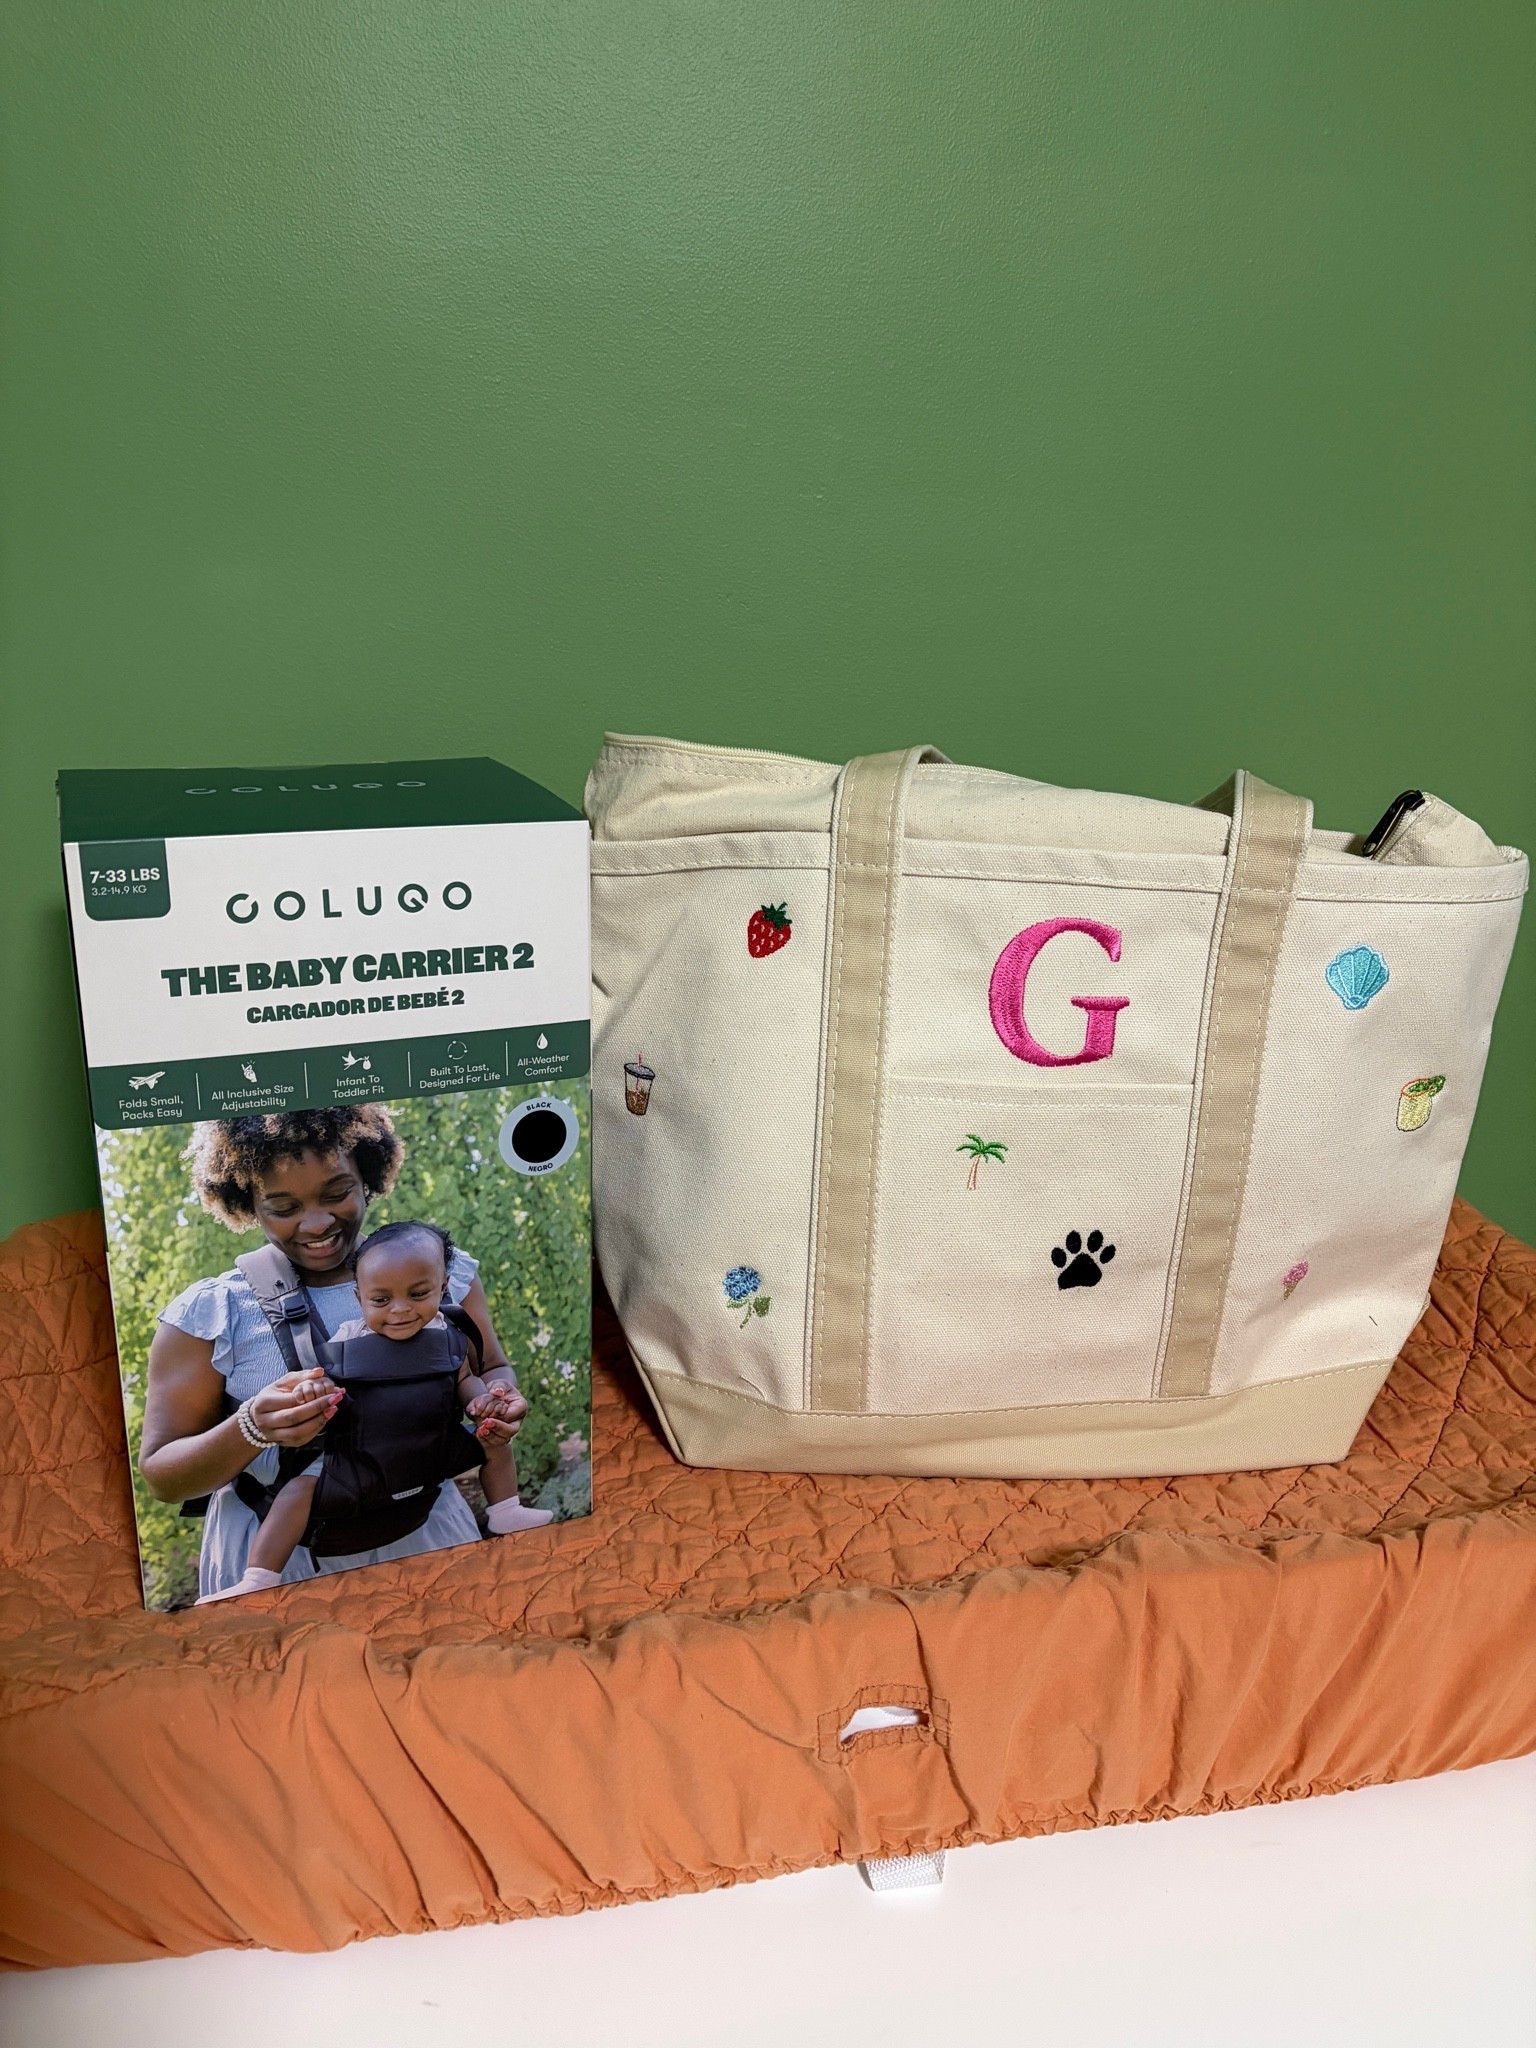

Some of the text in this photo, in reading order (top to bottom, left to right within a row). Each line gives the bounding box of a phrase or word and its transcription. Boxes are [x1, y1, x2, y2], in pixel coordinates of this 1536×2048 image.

[89, 867, 160, 884] 7-33 LBS
[91, 884, 147, 896] 3.2-14.9 KG
[161, 942, 535, 997] THE BABY CARRIER 2
[989, 917, 1131, 1067] G
[246, 986, 465, 1024] CARGADOR DE BEBÉ 2
[516, 1053, 570, 1068] All-Weather
[429, 1062, 490, 1077] Built To Last,
[524, 1063, 563, 1077] Comfort
[336, 1074, 381, 1088] Infant To
[419, 1071, 501, 1090] Designed For Life
[211, 1084, 295, 1101] All Inclusive Size
[332, 1084, 386, 1099] Toddler Fit
[118, 1095, 184, 1110] Folds Small,
[221, 1096, 286, 1112] Adjustability
[526, 1101, 553, 1112] BLACK
[122, 1107, 183, 1120] Packs Easy
[527, 1162, 554, 1173] NEGRO
